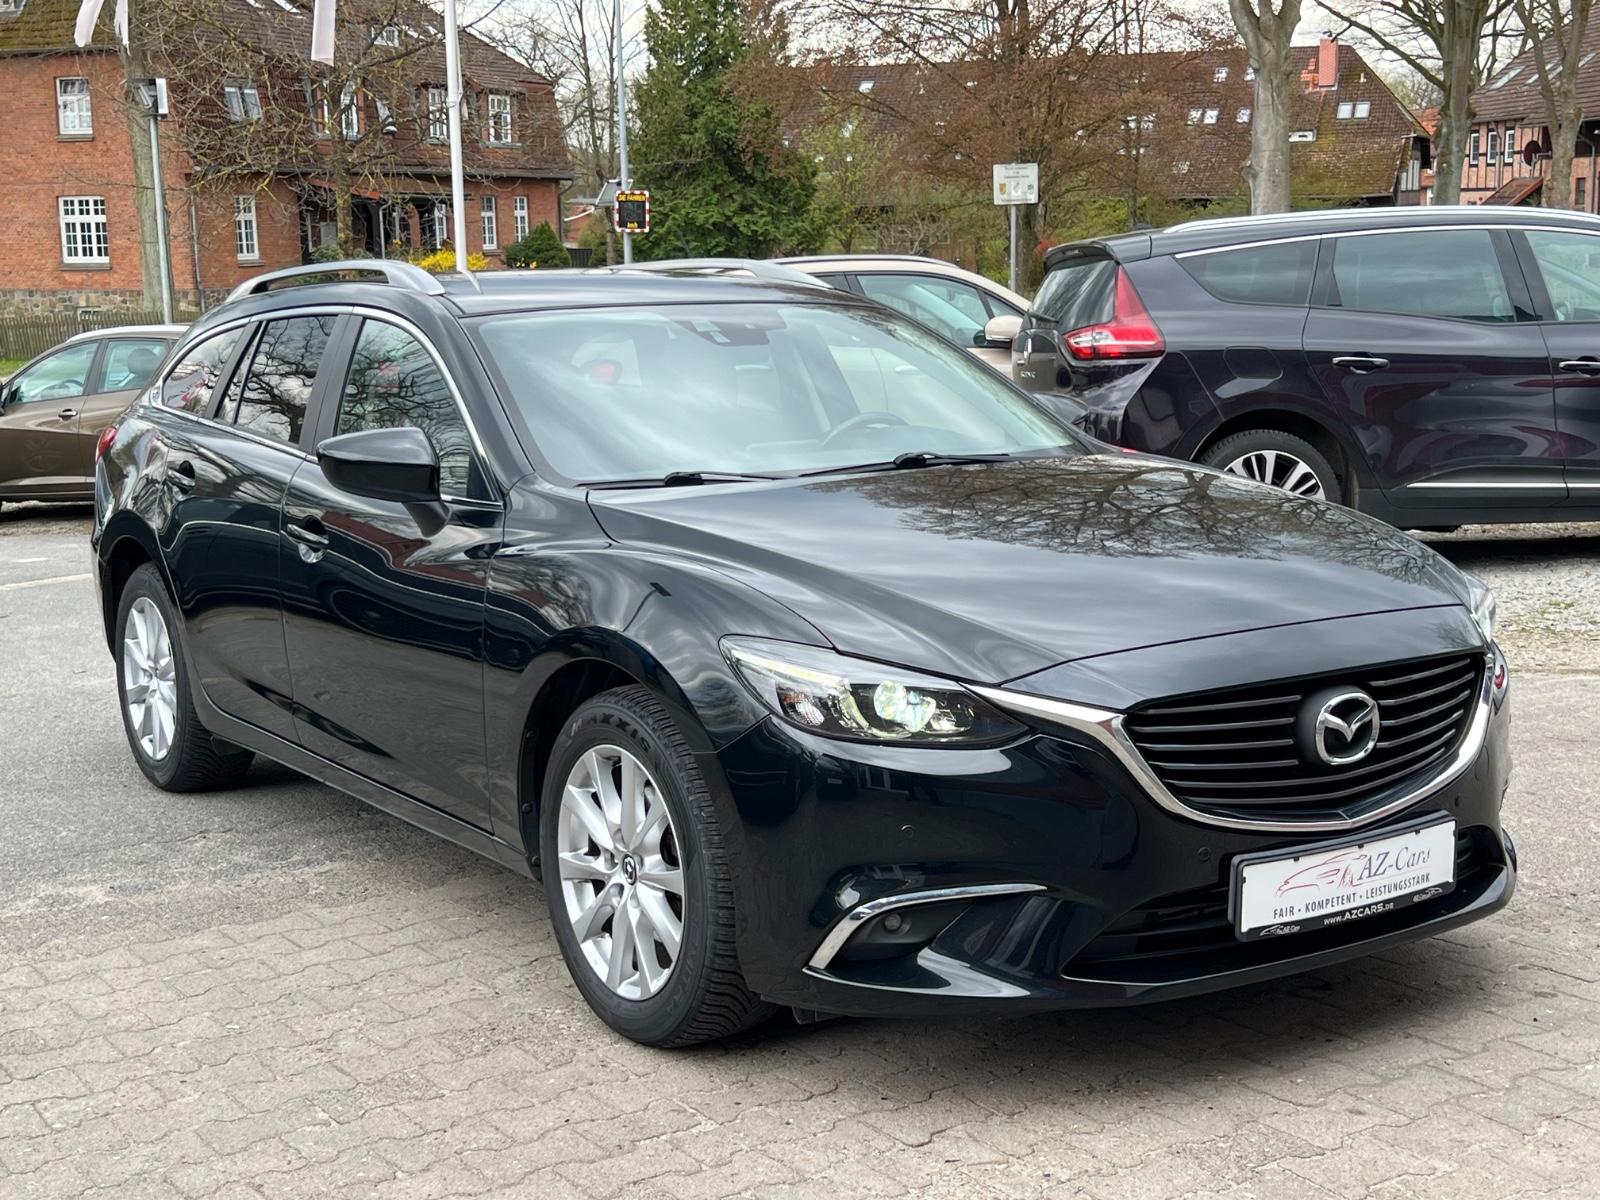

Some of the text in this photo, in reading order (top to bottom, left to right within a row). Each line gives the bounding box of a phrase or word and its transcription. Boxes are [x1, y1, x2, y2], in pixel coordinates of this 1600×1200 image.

[570, 713, 651, 753] MAXXIS
[1357, 846, 1431, 880] AZ-Cars
[1273, 905, 1295, 919] FAIR
[1305, 892, 1357, 913] KOMPETENT
[1366, 872, 1431, 899] LEISTUNGSSTARK
